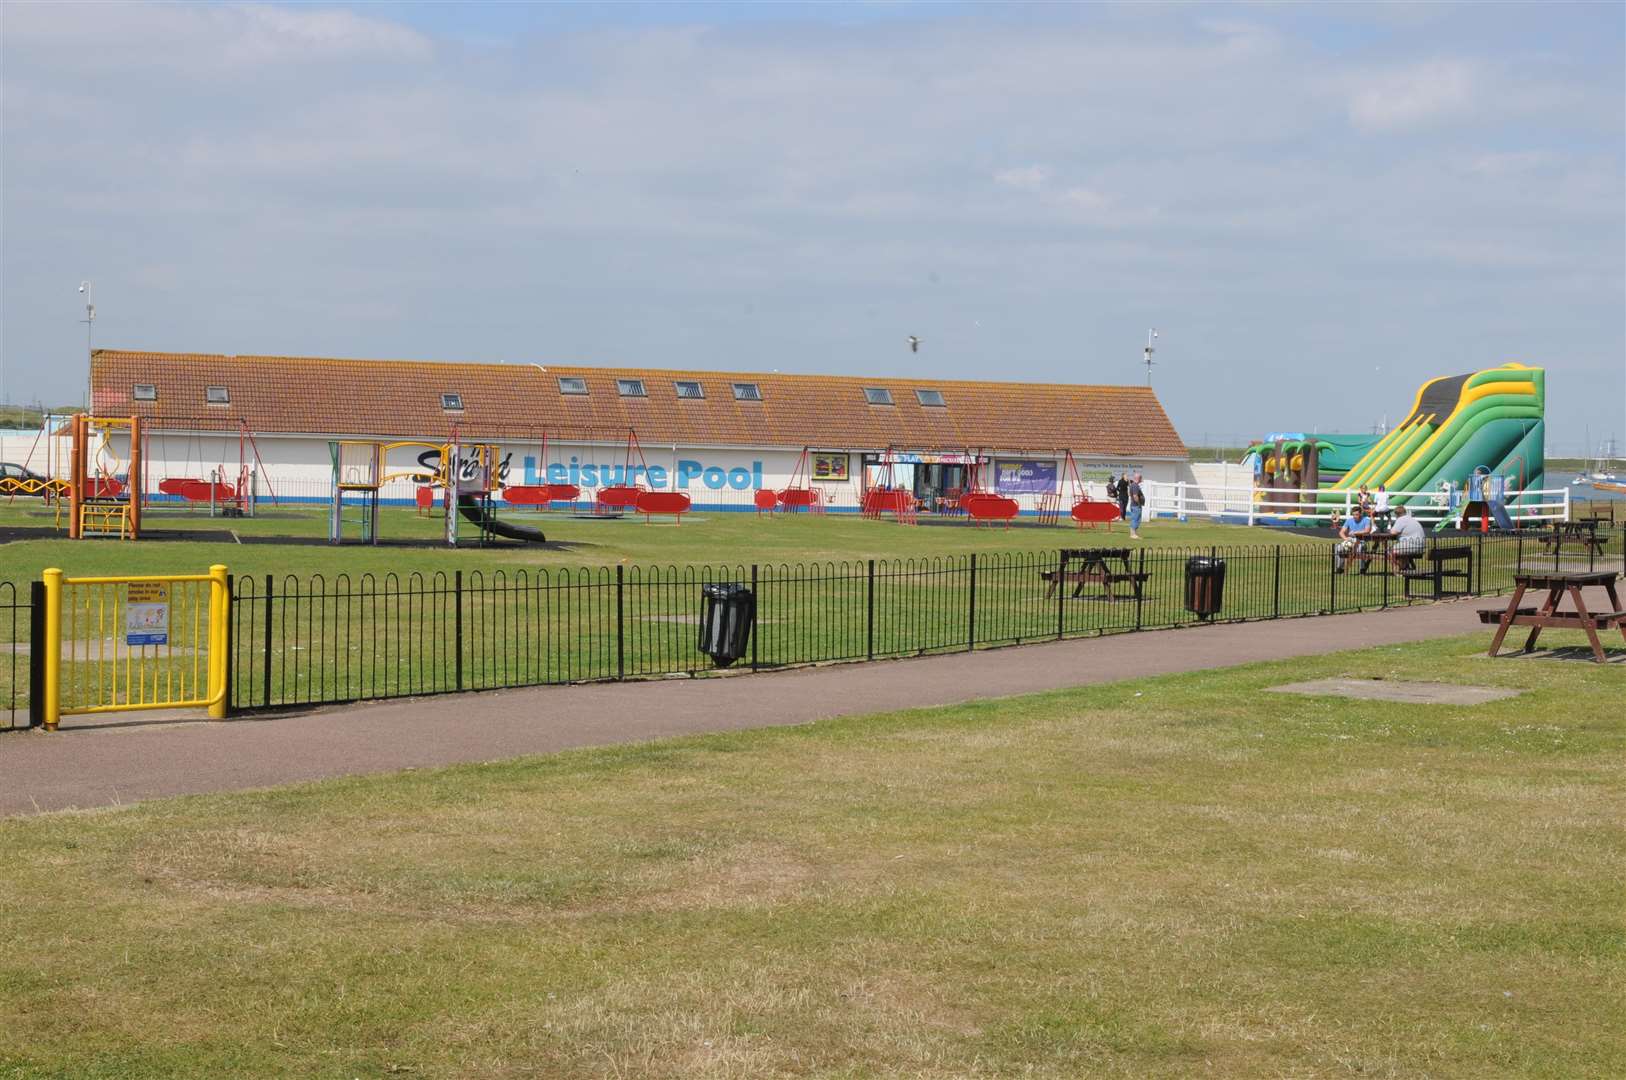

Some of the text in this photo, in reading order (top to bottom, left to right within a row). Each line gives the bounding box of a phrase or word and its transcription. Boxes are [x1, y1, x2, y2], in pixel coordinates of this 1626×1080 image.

[411, 443, 762, 489] Srad Leisure Pool
